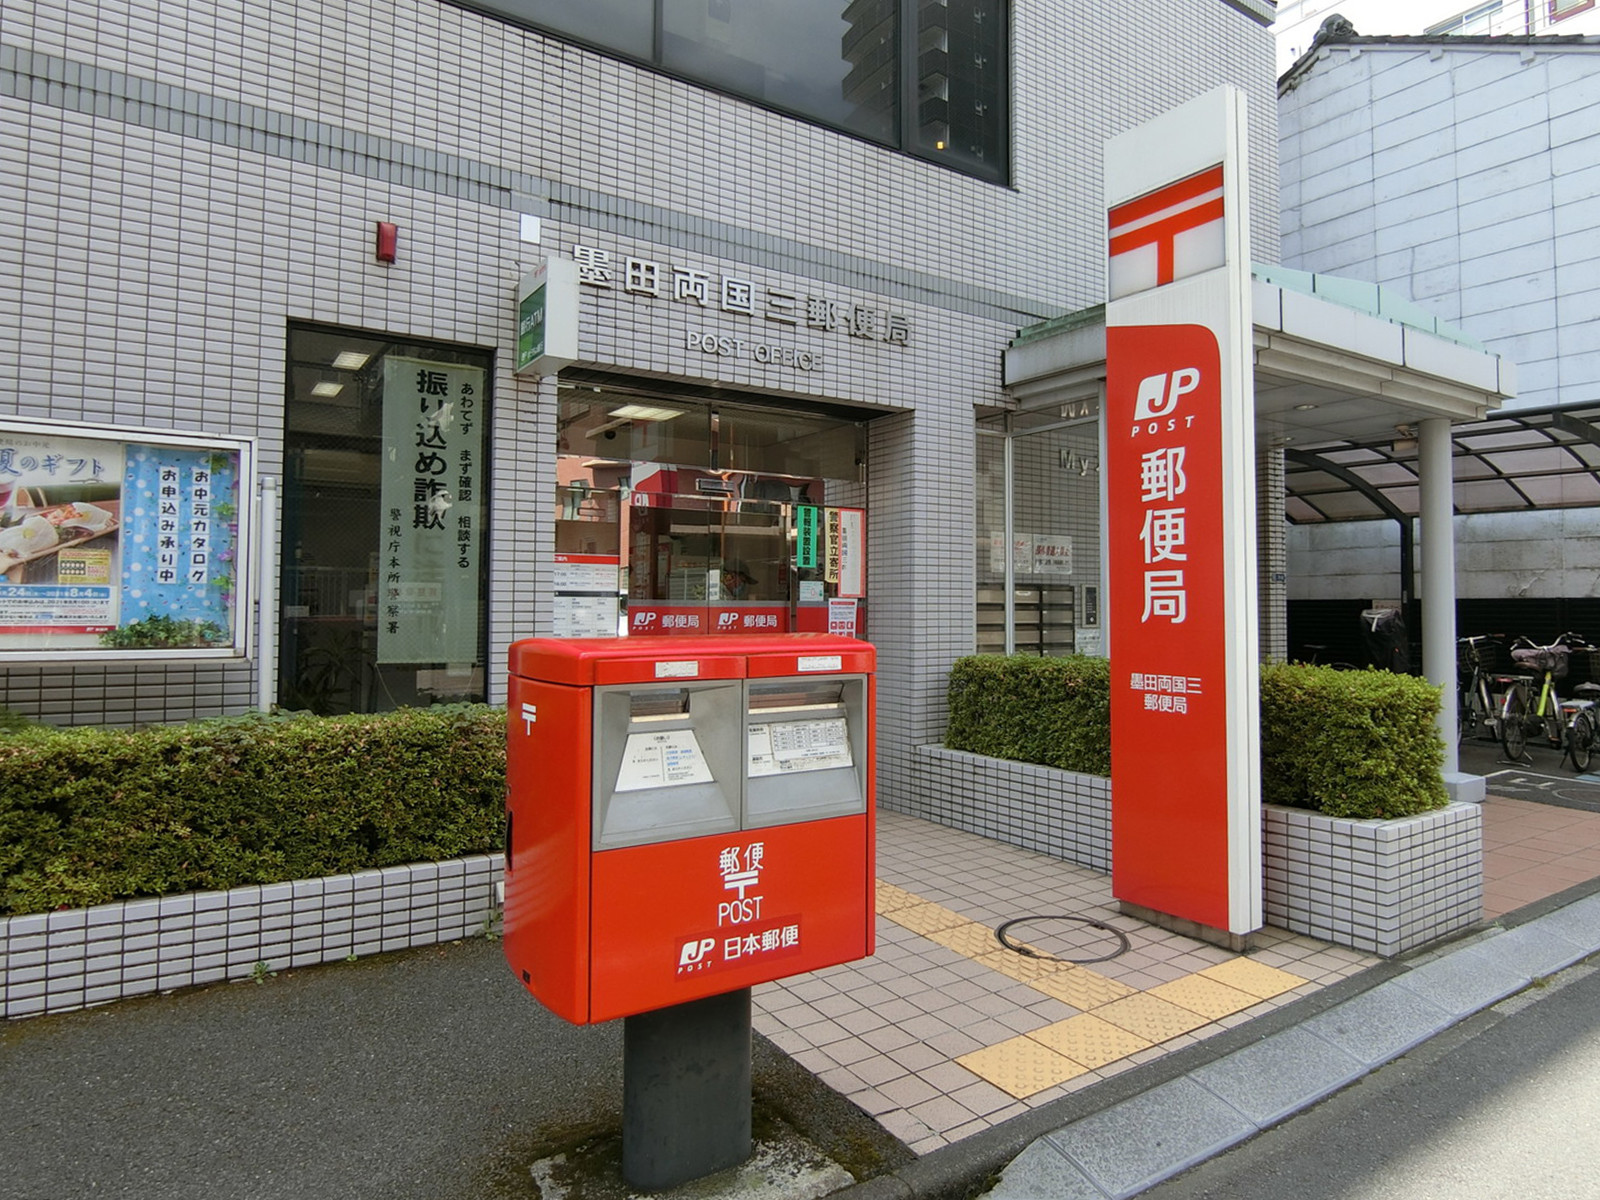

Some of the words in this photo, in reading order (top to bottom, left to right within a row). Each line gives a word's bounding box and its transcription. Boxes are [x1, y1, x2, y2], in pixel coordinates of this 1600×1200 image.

[573, 244, 912, 346] 墨田両国三郵便局
[687, 330, 746, 359] POST
[754, 344, 824, 372] OFFICE
[460, 383, 474, 435] あわてず
[1133, 367, 1200, 421] JP
[1131, 415, 1195, 437] POST
[459, 450, 472, 501] まず確認
[159, 469, 177, 583] お申込み承り中
[191, 470, 210, 583] お中元カタログ
[457, 516, 471, 568] 相談する
[1139, 447, 1187, 624] 郵便局
[386, 508, 402, 634] 警視庁本所警察署
[662, 615, 700, 628] 郵便局
[743, 615, 777, 628] 郵便局
[1129, 673, 1203, 694] 墨田両国三
[1143, 694, 1188, 714] 郵便局
[719, 842, 764, 876] 郵便
[718, 896, 763, 927] POST
[679, 937, 716, 966] JP
[724, 924, 799, 961] 日本郵便
[677, 960, 713, 974] POST
